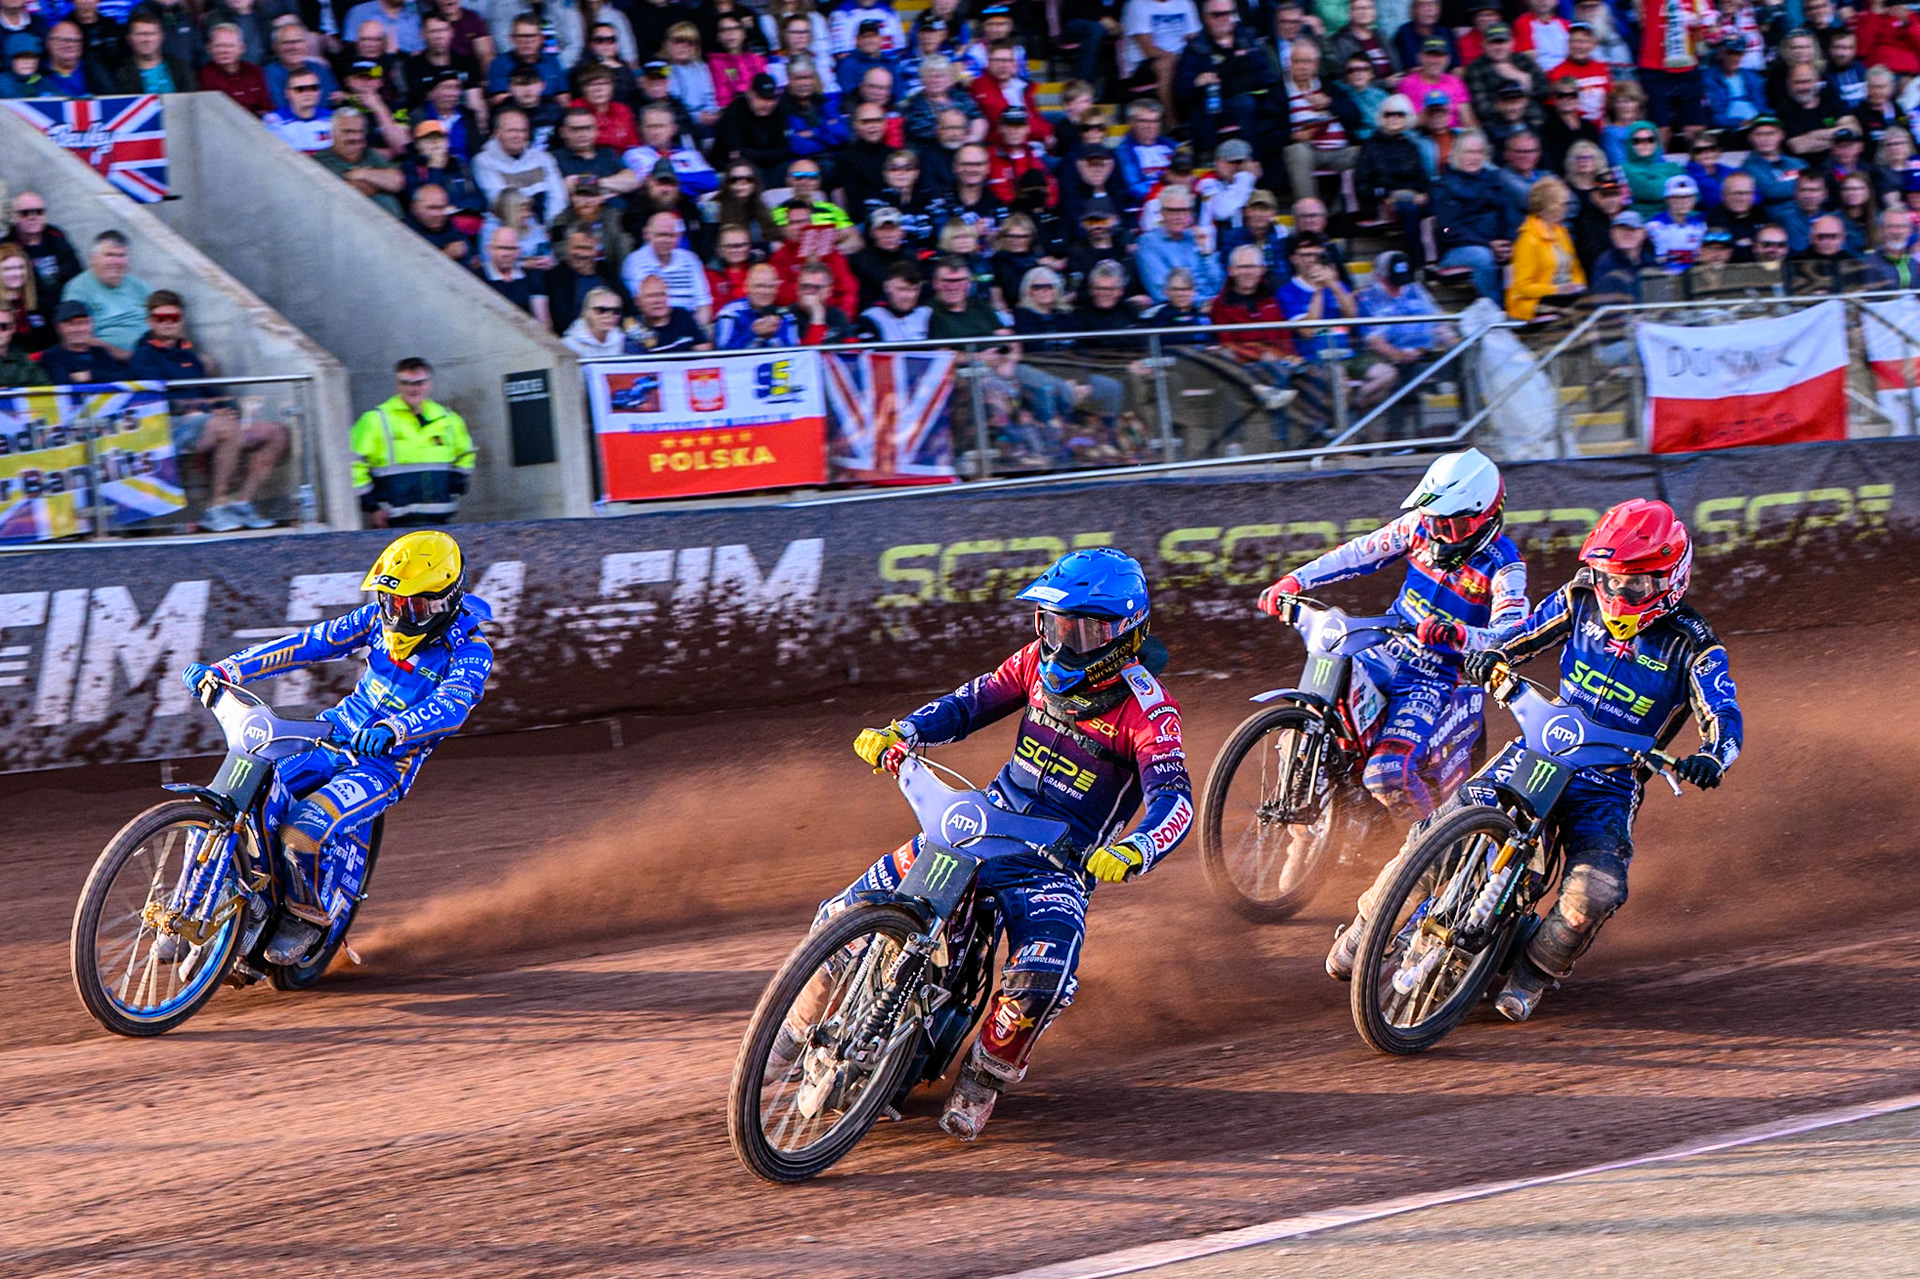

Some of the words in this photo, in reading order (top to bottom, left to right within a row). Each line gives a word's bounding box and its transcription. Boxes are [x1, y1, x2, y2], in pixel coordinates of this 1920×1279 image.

[650, 445, 777, 473] POLSKA
[1581, 620, 1607, 641] FIM
[1636, 654, 1669, 673] SGP
[1568, 659, 1637, 705] SGP
[1469, 692, 1483, 714] 99
[1600, 702, 1624, 718] GRAND
[1623, 712, 1642, 726] PRIX
[402, 702, 441, 728] MCG
[244, 725, 268, 742] ATPI
[1547, 725, 1577, 746] ATPI
[1016, 735, 1080, 778] SGP
[1043, 775, 1067, 793] GRAND
[1066, 786, 1084, 801] PRIX
[306, 799, 327, 817] ORLEN
[947, 812, 980, 835] ATPI
[1151, 802, 1191, 850] SONAX
